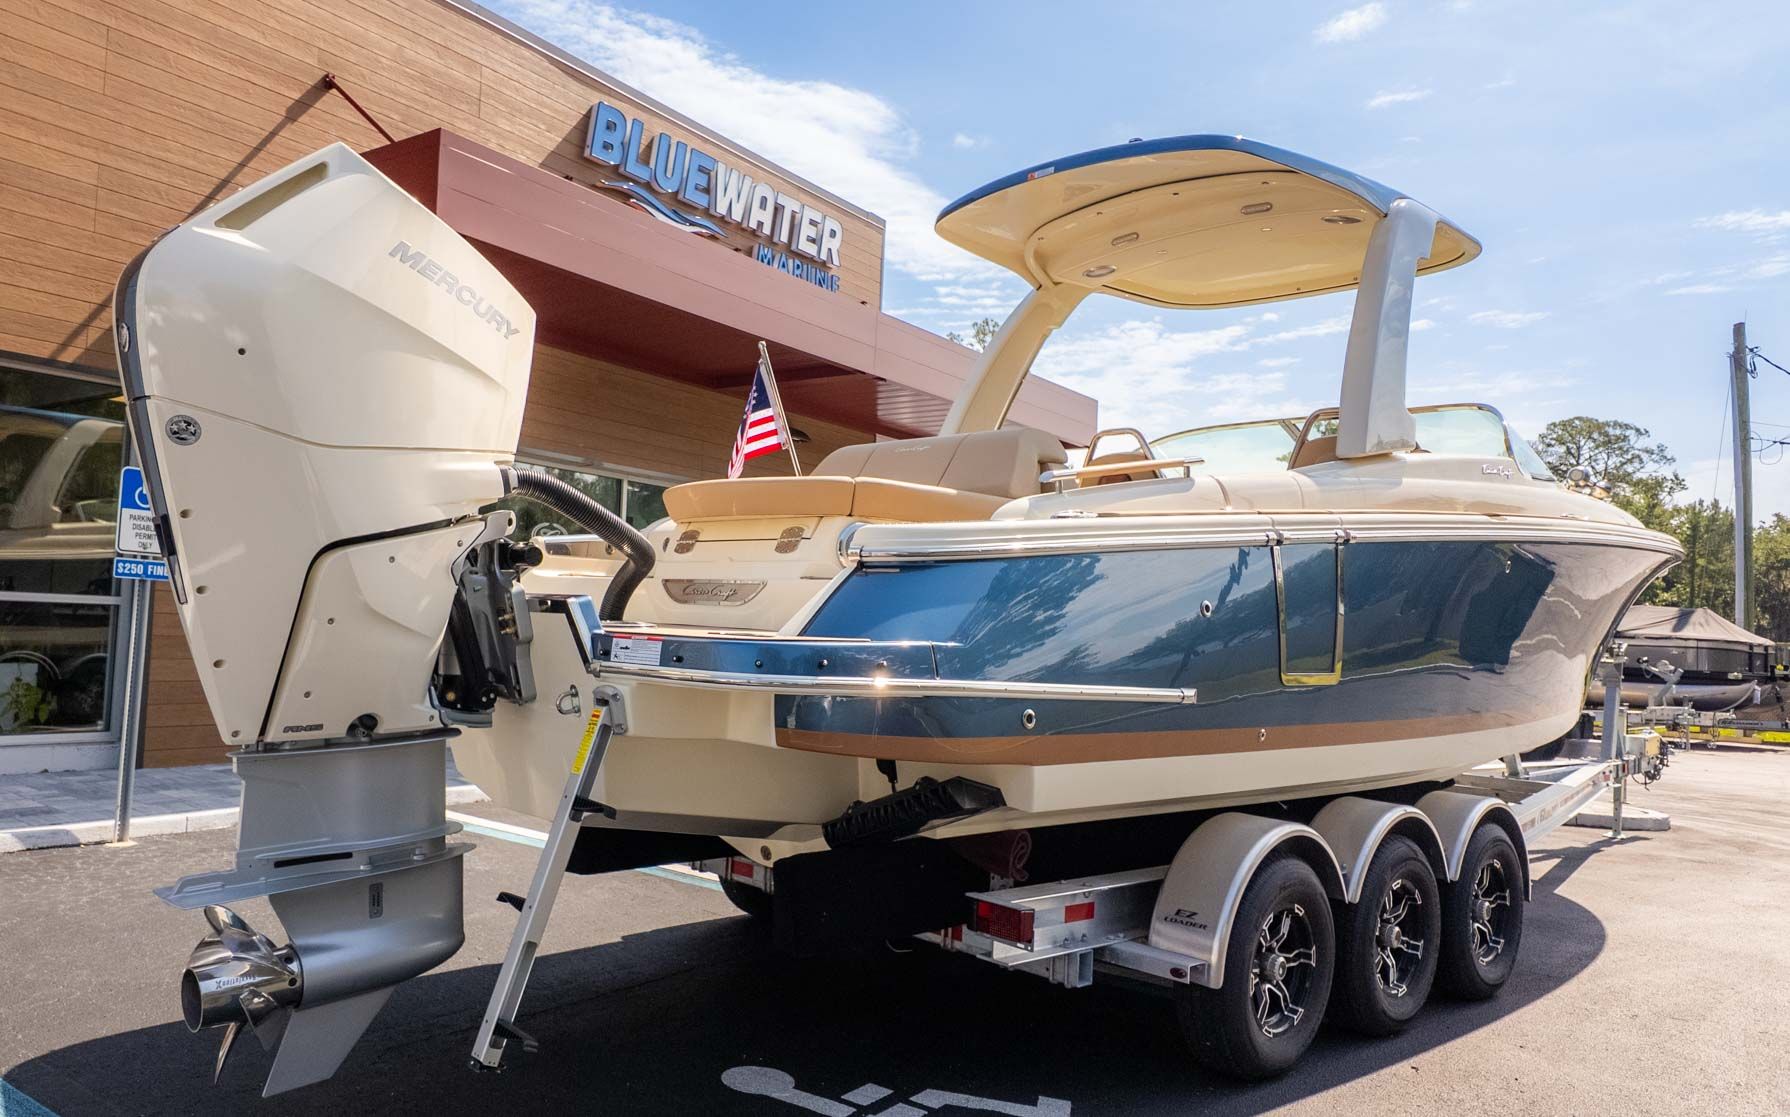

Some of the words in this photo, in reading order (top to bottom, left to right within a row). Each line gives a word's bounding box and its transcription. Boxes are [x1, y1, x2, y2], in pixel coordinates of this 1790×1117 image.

[588, 101, 842, 266] BLUEWATER
[757, 243, 840, 293] MARINE
[388, 240, 520, 339] MERCURY
[129, 513, 153, 523] PARKIN
[117, 561, 144, 575] $250
[1174, 909, 1199, 920] EZ
[1164, 916, 1208, 930] LOADER
